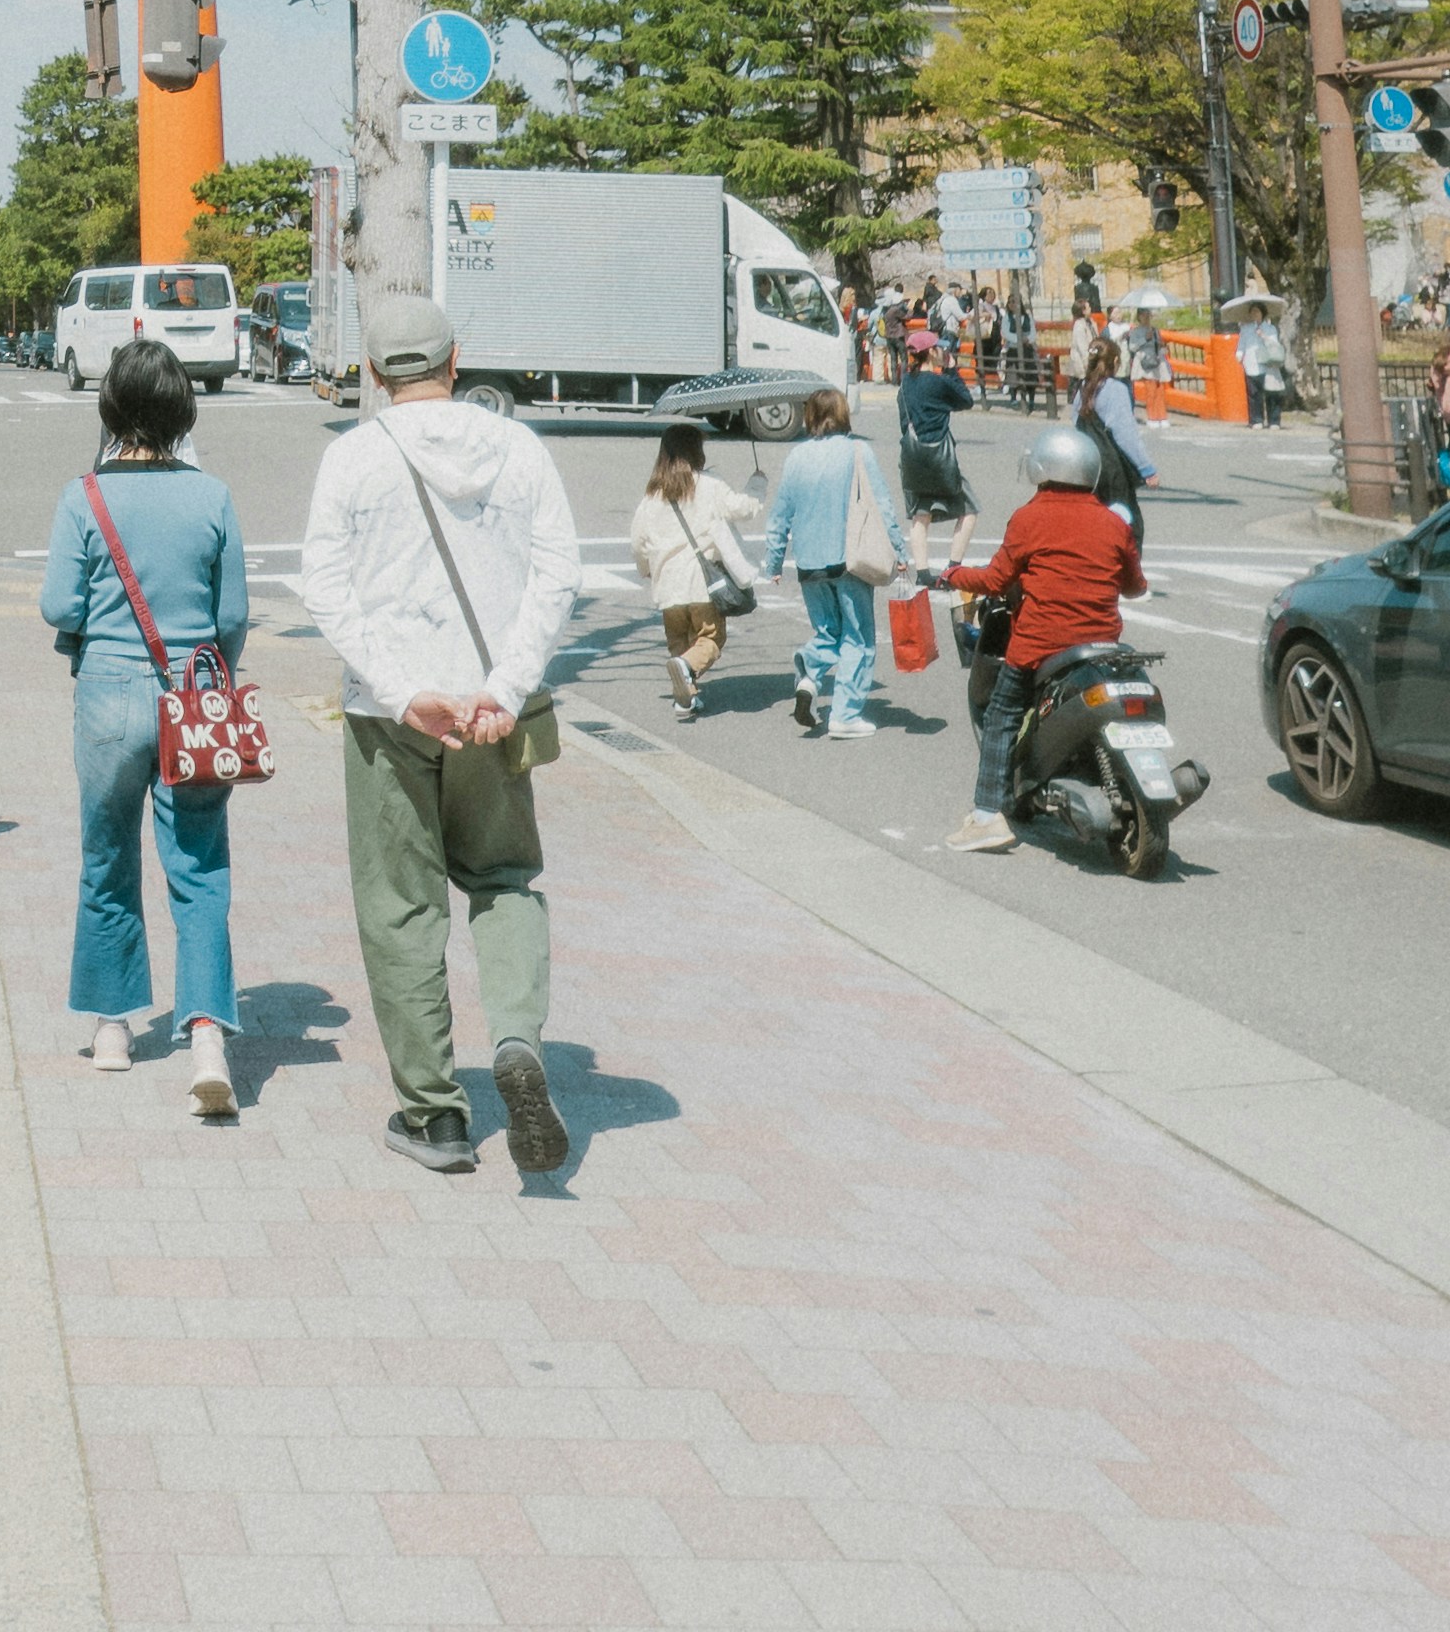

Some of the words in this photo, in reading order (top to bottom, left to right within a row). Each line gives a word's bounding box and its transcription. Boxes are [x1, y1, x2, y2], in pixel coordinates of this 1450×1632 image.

[1240, 14, 1257, 41] 40
[408, 114, 491, 131] ここまで
[448, 241, 494, 253] ALITY
[448, 258, 494, 270] STICS
[125, 576, 159, 645] MICHAEL
[181, 723, 219, 748] MK
